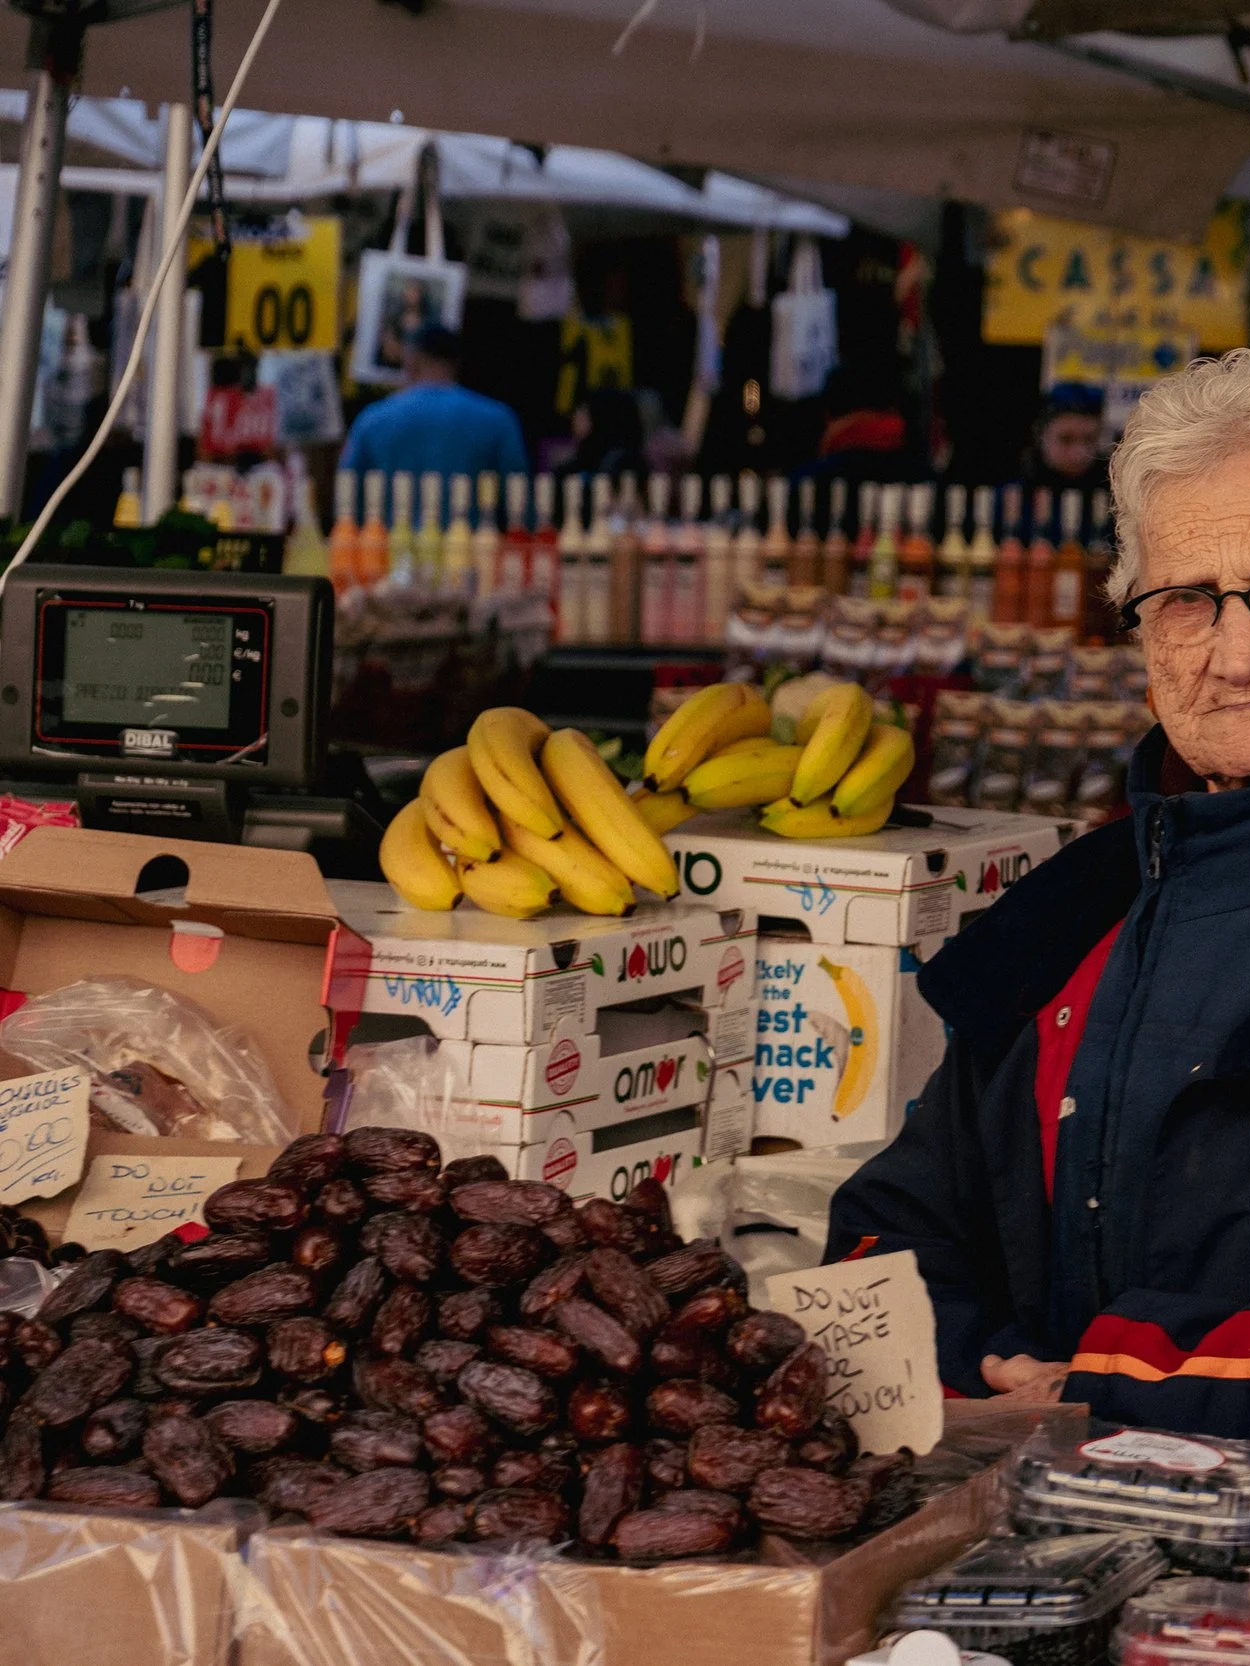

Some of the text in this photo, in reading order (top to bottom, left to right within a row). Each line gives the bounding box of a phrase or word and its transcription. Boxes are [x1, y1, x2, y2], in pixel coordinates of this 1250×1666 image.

[1016, 244, 1217, 297] CASSA
[124, 732, 172, 748] DIBAL
[762, 985, 792, 1000] the
[112, 1164, 150, 1179] DO
[147, 1175, 207, 1193] NOT
[85, 1203, 199, 1222] TOUCH!
[793, 1277, 891, 1317] DO NOT
[814, 1311, 891, 1352] TASTE
[824, 1358, 864, 1378] OR
